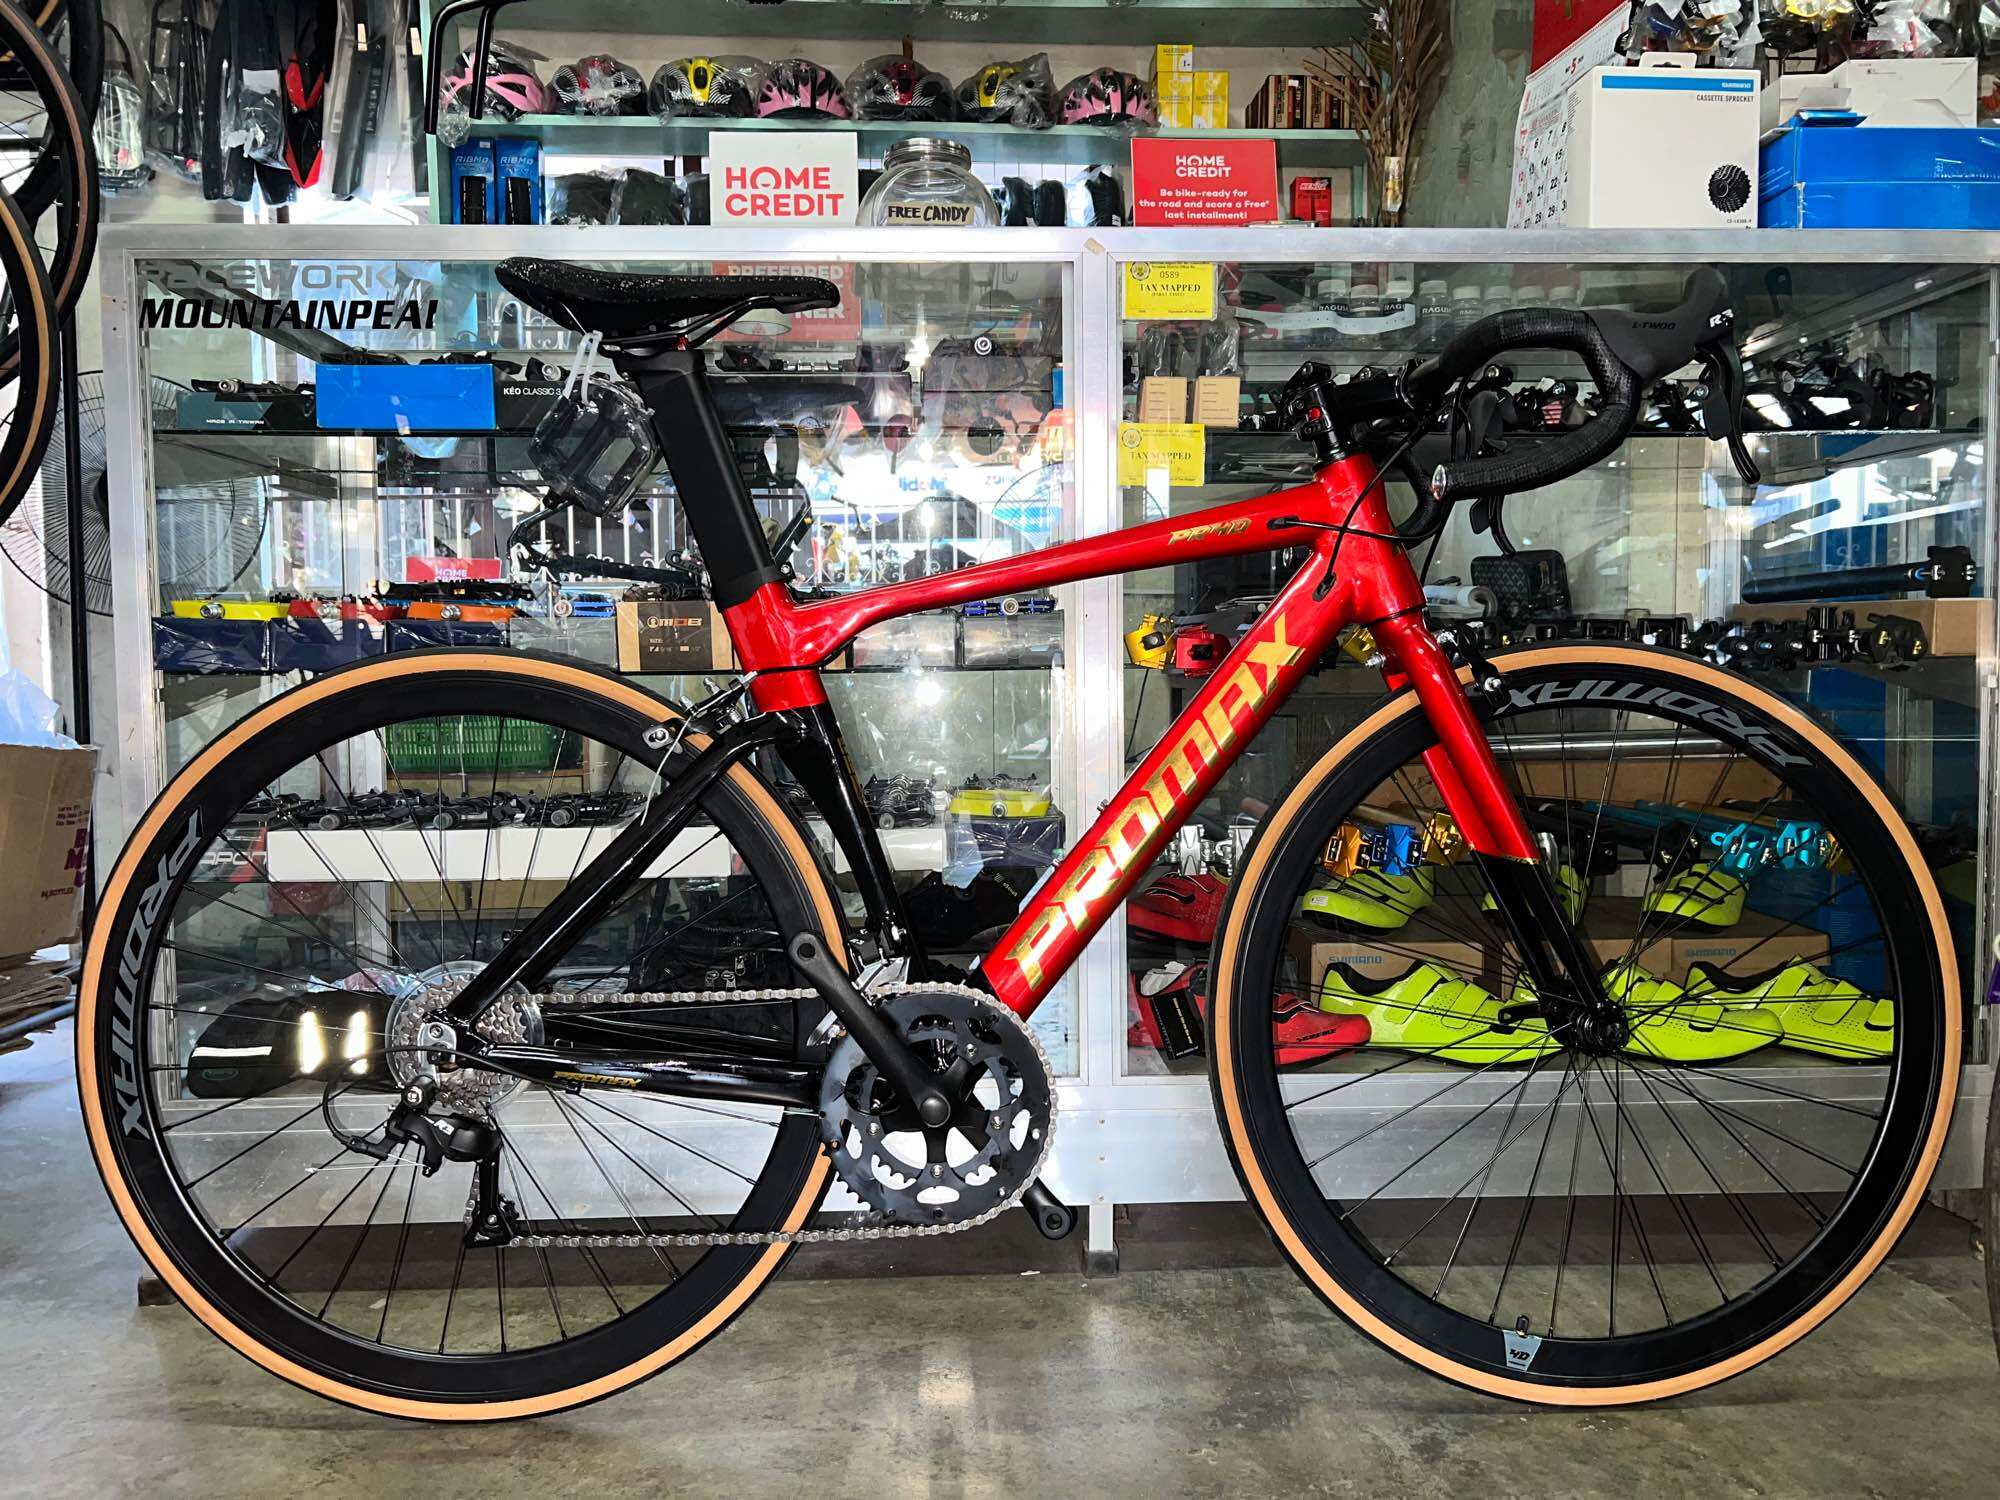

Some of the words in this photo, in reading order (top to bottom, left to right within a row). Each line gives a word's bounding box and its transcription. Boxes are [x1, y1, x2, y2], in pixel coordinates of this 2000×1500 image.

[1696, 94, 1723, 102] CASSETTE
[1725, 95, 1754, 103] SPROCKET
[1176, 155, 1225, 166] HOME
[725, 166, 831, 190] HOME
[1176, 167, 1231, 178] CREDIT
[1160, 188, 1173, 197] Be
[1175, 188, 1230, 199] bike-ready
[1232, 188, 1248, 197] for
[725, 193, 844, 217] CREDIT
[1139, 199, 1156, 208] the
[1158, 199, 1181, 208] road
[1184, 199, 1203, 208] and
[888, 205, 921, 218] FREE
[923, 205, 970, 222] CANDY
[1165, 210, 1184, 219] last
[1187, 210, 1248, 219] installment!
[1140, 284, 1158, 292] TAX
[1161, 283, 1201, 292] MAPPED
[523, 387, 554, 396] CLASSIC
[1130, 451, 1148, 460] TAX
[1494, 680, 1816, 767] PROMAX
[1005, 612, 1306, 991] PROMAX
[112, 808, 202, 1140] PROMAX
[553, 1070, 642, 1087] PROMAX
